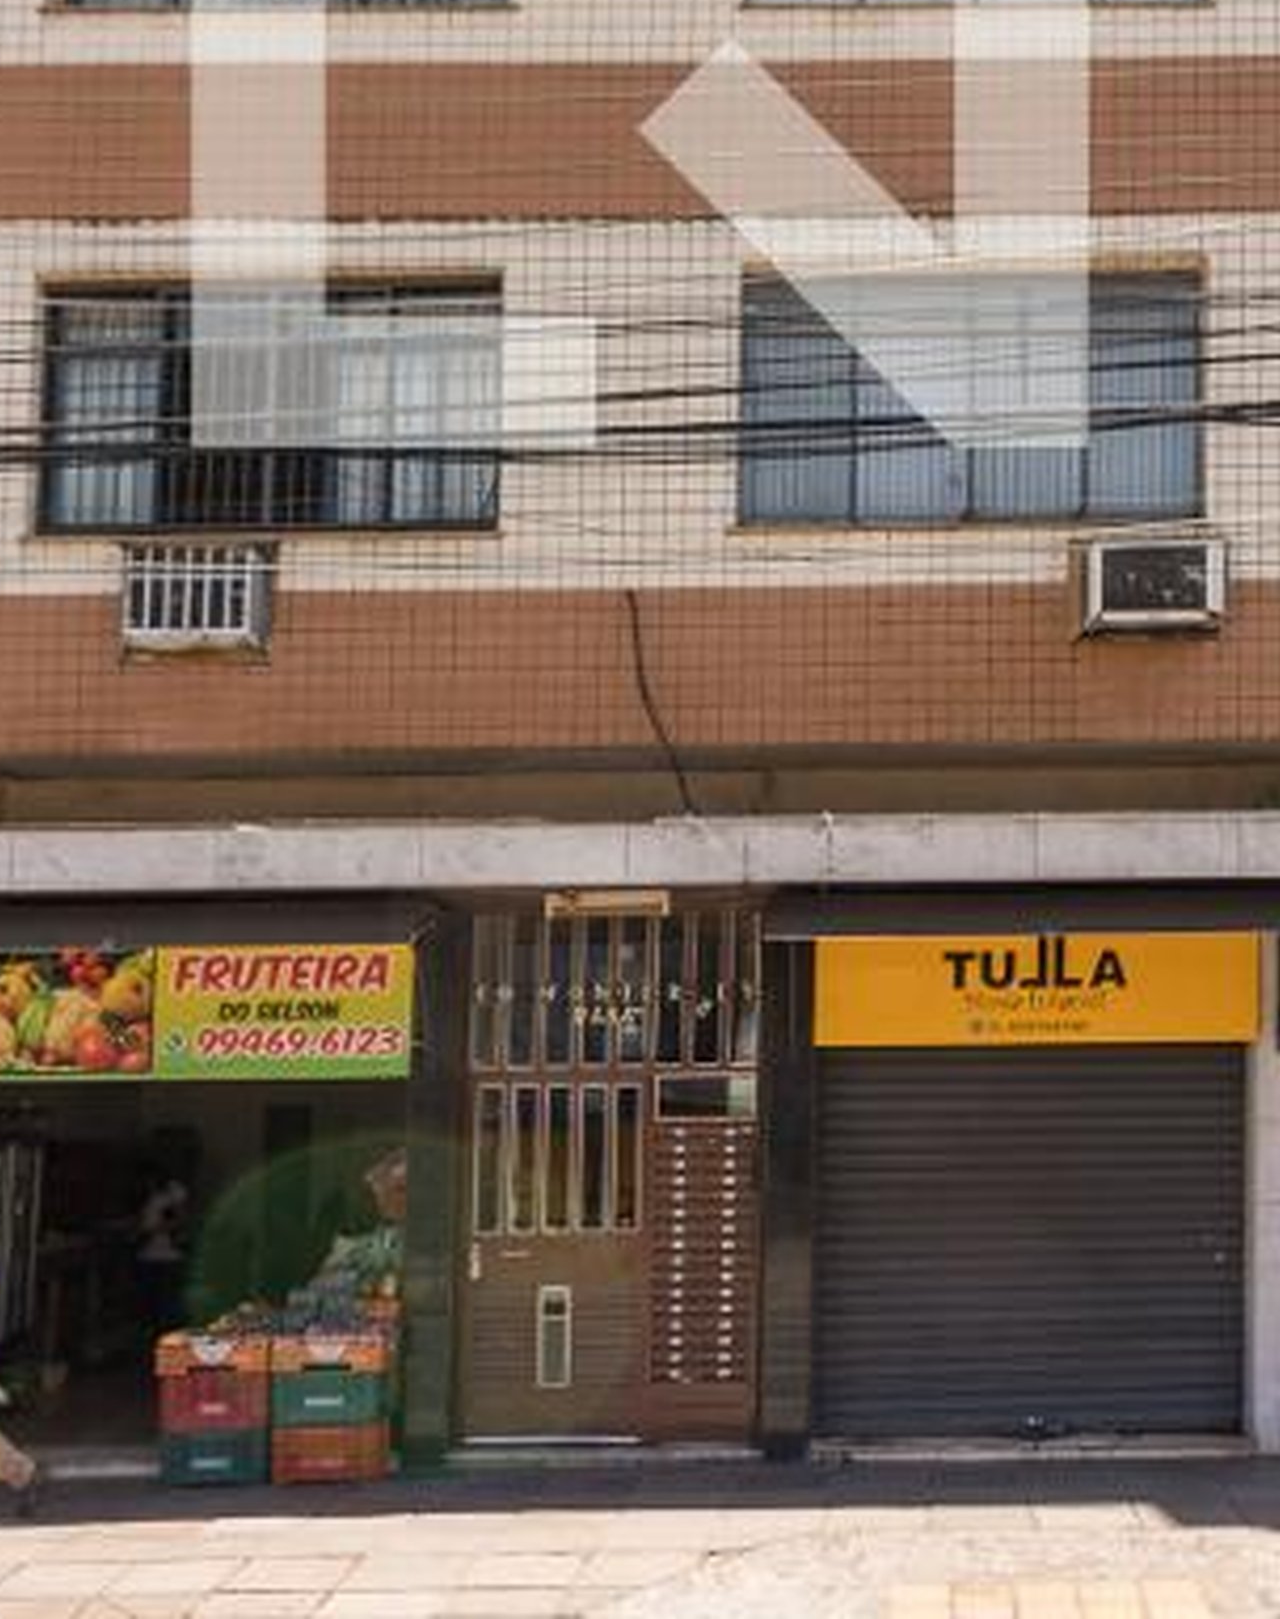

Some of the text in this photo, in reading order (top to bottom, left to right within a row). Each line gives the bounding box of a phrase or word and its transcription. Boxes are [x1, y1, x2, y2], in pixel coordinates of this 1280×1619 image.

[174, 952, 392, 993] FRUTEIRA
[943, 935, 1127, 990] TULLA
[218, 1001, 251, 1022] DO
